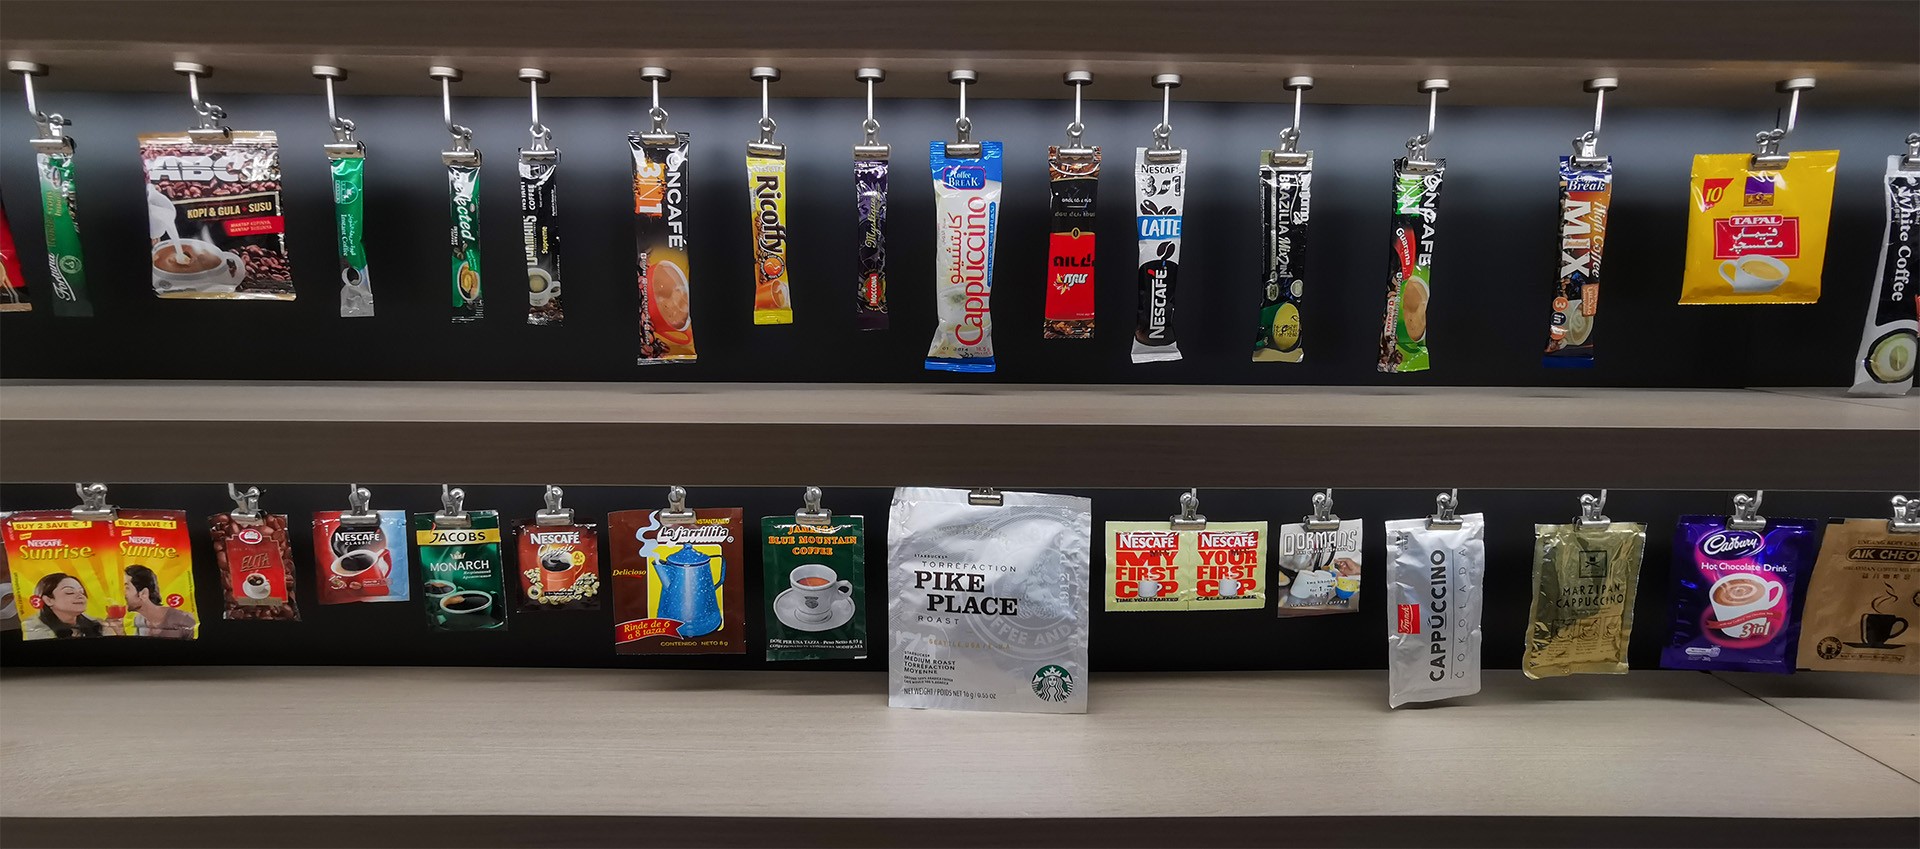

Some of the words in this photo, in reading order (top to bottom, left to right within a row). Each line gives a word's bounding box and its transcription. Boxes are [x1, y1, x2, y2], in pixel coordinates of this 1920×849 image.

[148, 154, 244, 183] ABC
[948, 176, 979, 187] BREAK
[1142, 175, 1157, 197] 3
[1567, 180, 1606, 193] Break
[528, 184, 536, 211] COFFEE
[1705, 186, 1723, 204] 10
[187, 208, 208, 219] KOPI
[208, 208, 217, 217] &
[217, 206, 241, 216] GULA
[248, 201, 273, 213] SUSU
[1277, 174, 1291, 235] BRAZILIA
[756, 174, 787, 255] Ricoffy
[1589, 200, 1607, 231] High
[1732, 216, 1781, 225] TAPAL
[1897, 185, 1914, 243] White
[341, 214, 349, 236] Instant
[1141, 218, 1181, 238] LATTE
[541, 225, 549, 255] Supreme
[1561, 198, 1592, 278] MIX
[341, 236, 350, 257] Coffee
[1395, 227, 1411, 266] Guarana
[1592, 236, 1605, 278] Coffee
[49, 252, 75, 301] Fortuna
[955, 195, 991, 347] Cappuccino
[1891, 245, 1912, 302] Coffee
[869, 274, 879, 306] MOCCONA
[1555, 300, 1567, 309] 3
[1553, 313, 1565, 324] in
[16, 522, 35, 530] BUY
[46, 521, 69, 529] SAVE
[118, 519, 133, 527] BUY
[334, 528, 381, 542] NESCAFÉ
[428, 532, 486, 544] JACOBS
[529, 531, 581, 545] NESCAFÉ
[768, 535, 796, 545] BLUE
[798, 535, 858, 545] MOUNTAIN
[1119, 533, 1177, 549] NESCAFÉ
[1201, 532, 1258, 548] NESCAFÉ
[1283, 529, 1358, 556] DORMANS
[18, 543, 93, 560] Sunrise
[119, 540, 177, 559] Sunrise
[791, 546, 834, 556] COFFEE
[1703, 534, 1759, 556] Cadbury
[1115, 551, 1179, 567] MY
[1197, 549, 1258, 566] YOUR
[1850, 549, 1876, 559] AIK
[430, 559, 490, 572] MONARCH
[612, 568, 647, 577] Delicioso
[921, 560, 1017, 573] TORRÉFACTION
[1115, 566, 1179, 581] FIRST
[1196, 564, 1258, 579] FIRST
[1701, 562, 1718, 571] Hot
[1719, 562, 1761, 572] Chocolate
[1763, 563, 1788, 573] Drink
[913, 570, 985, 593] PIKE
[1562, 583, 1621, 597] MARZIPAN
[32, 597, 41, 609] 3
[170, 595, 181, 607] 3
[926, 593, 1018, 617] PLACE
[1555, 593, 1625, 609] CAPPUCCINO
[917, 615, 960, 625] ROAST
[1400, 604, 1411, 634] Franck
[1454, 548, 1467, 679] ČOKOLADA
[623, 623, 649, 633] Rinde
[650, 620, 662, 628] de
[664, 620, 671, 628] 6
[635, 630, 641, 638] 8
[643, 626, 666, 636] tazas
[1033, 623, 1073, 646] AND
[904, 655, 931, 665] MEDIUM
[904, 660, 956, 671] TORRÉFACTION
[904, 667, 938, 675] MOYENNE
[903, 687, 914, 695] NET
[913, 688, 934, 696] WEIGHT
[937, 688, 953, 697] POIDS
[963, 690, 970, 699] 16
